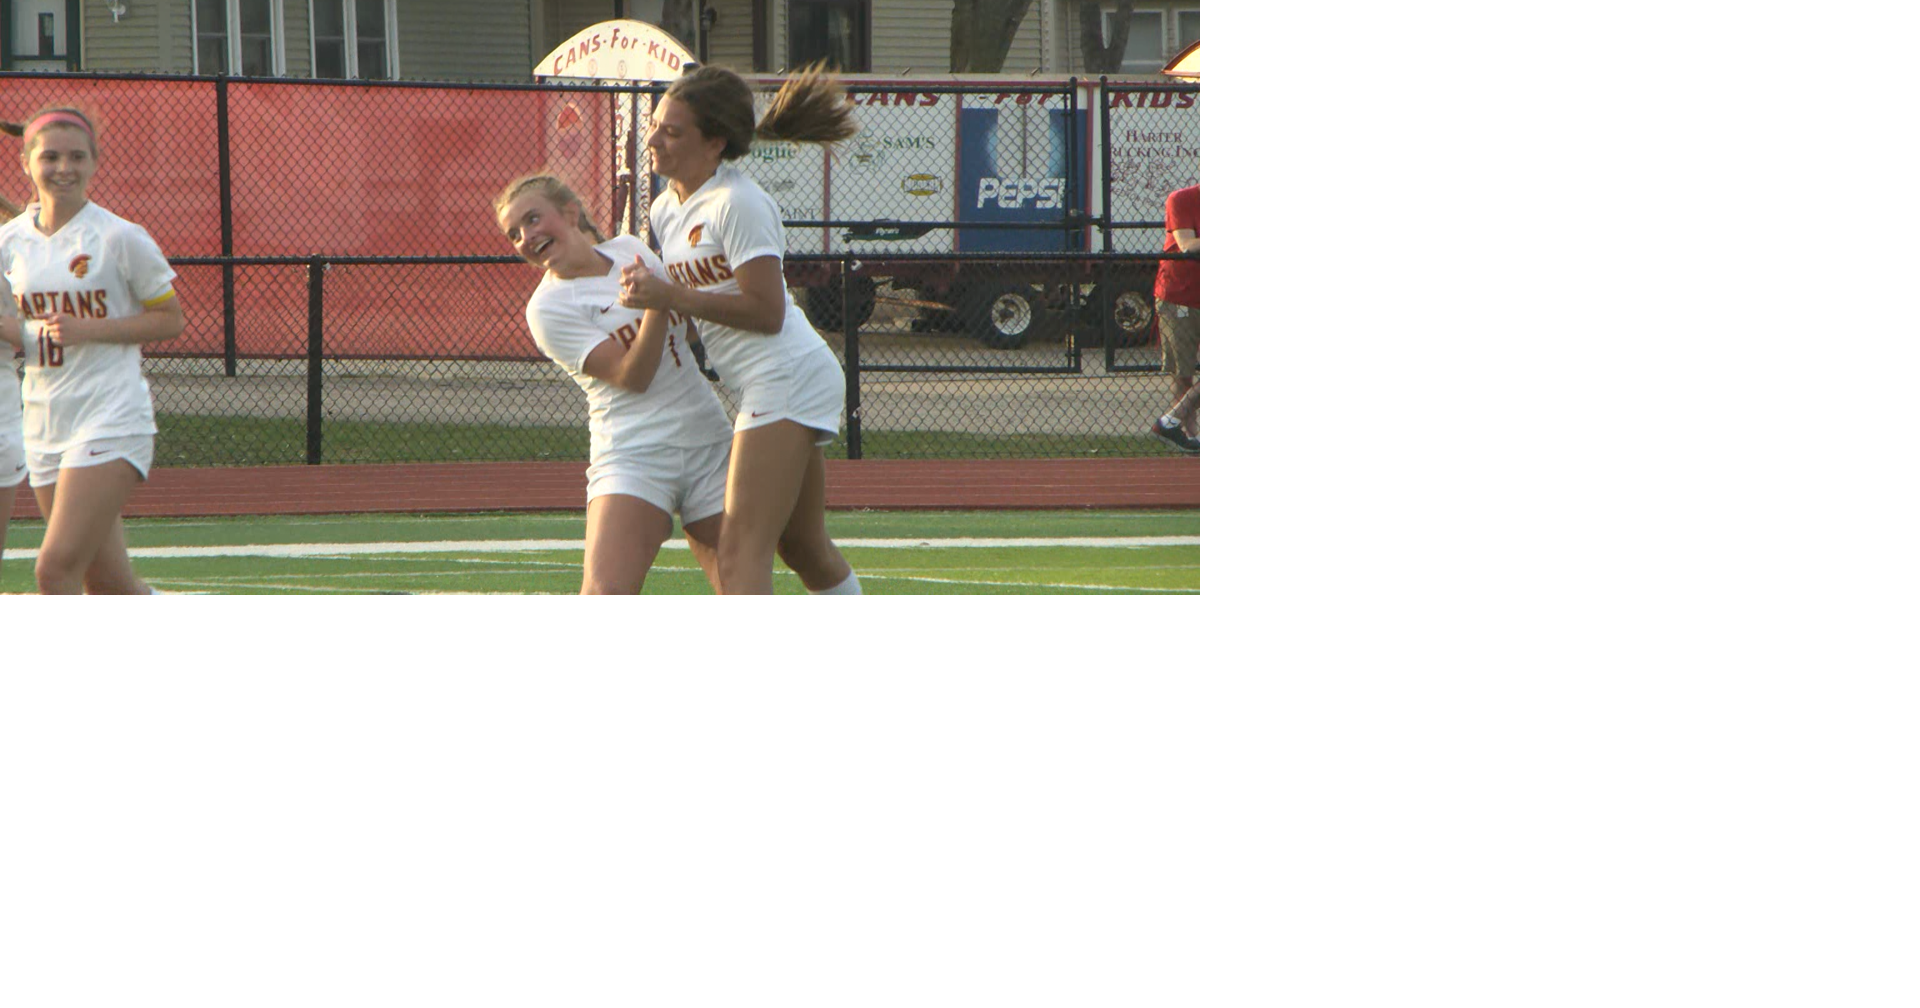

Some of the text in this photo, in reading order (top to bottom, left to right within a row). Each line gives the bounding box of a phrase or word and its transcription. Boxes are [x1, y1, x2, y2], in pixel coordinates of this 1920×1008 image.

[1111, 92, 1197, 108] KIDS
[883, 136, 936, 149] SAM'S
[750, 145, 797, 164] ogue
[977, 178, 1066, 208] PEPSI
[12, 289, 108, 319] ARTANS
